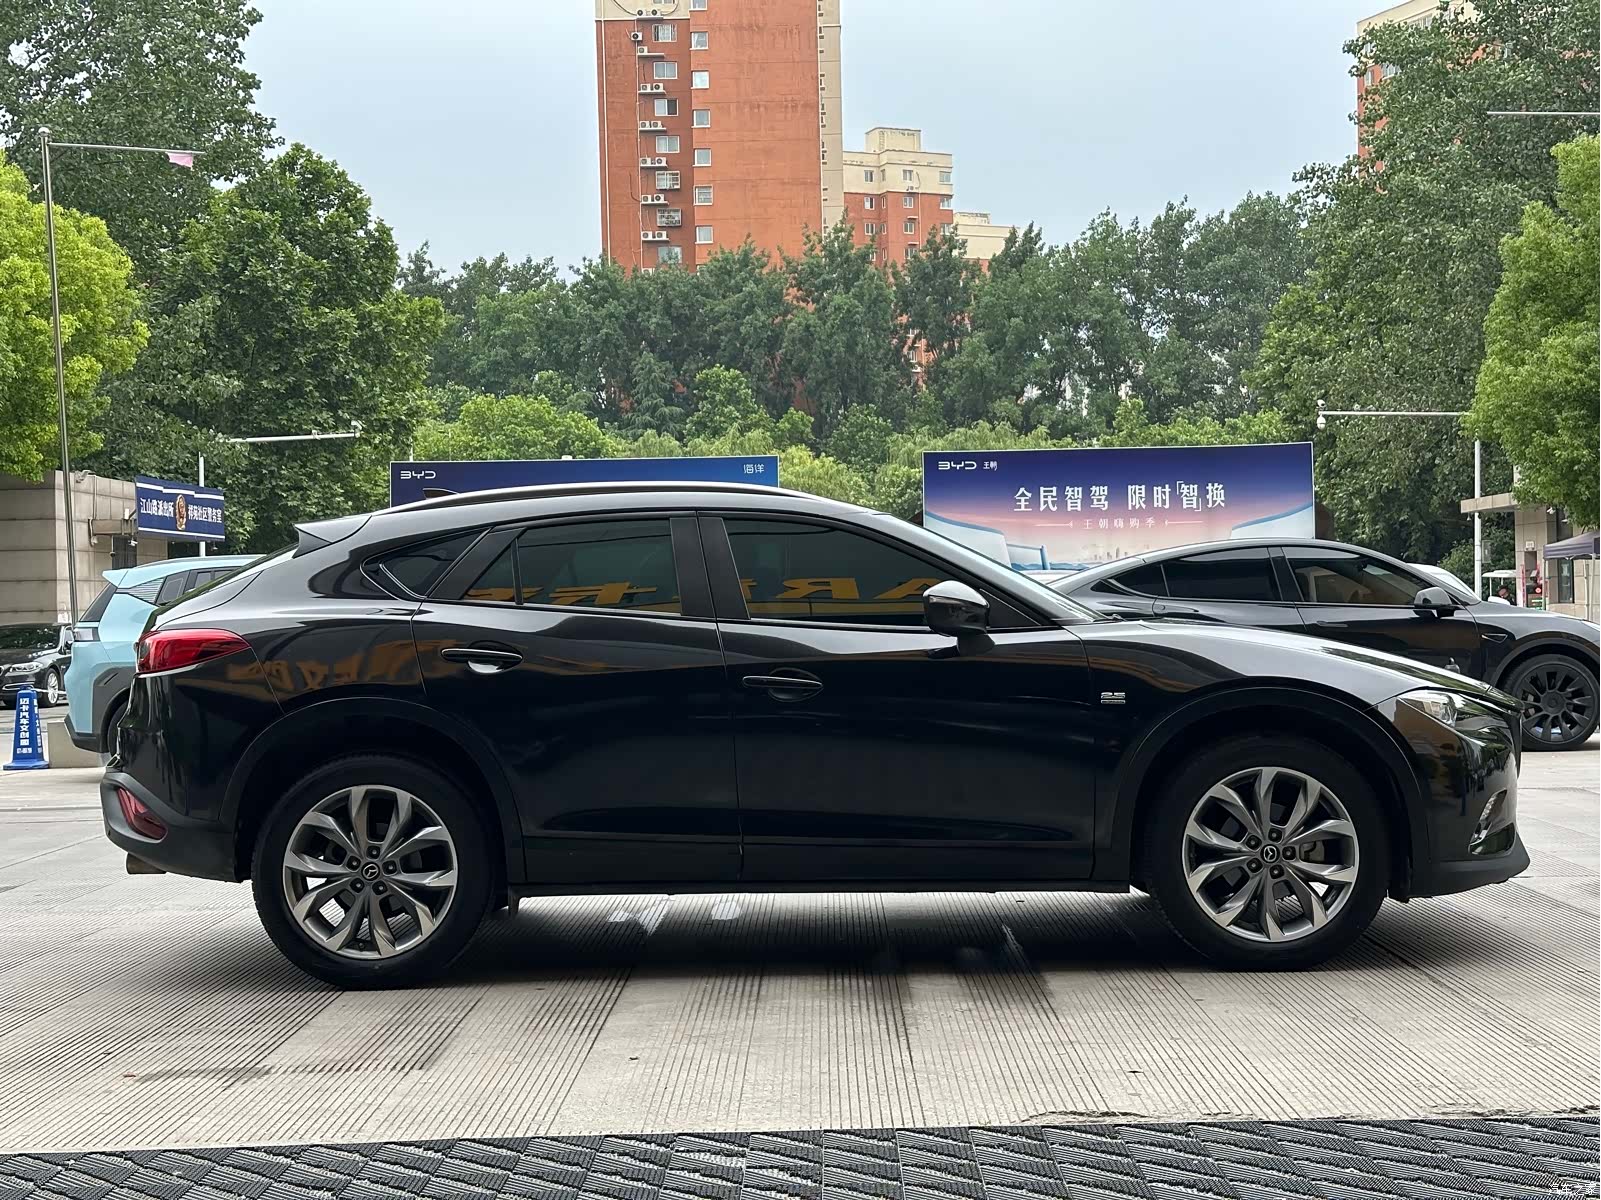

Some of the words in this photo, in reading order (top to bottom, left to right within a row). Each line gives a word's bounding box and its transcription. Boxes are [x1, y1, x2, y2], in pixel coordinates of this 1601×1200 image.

[743, 463, 765, 474] 海洋
[938, 461, 977, 470] BYD
[400, 470, 436, 479] BYD
[1014, 485, 1109, 512] 全民智驾
[1083, 517, 1156, 530] 王朝嗨购季
